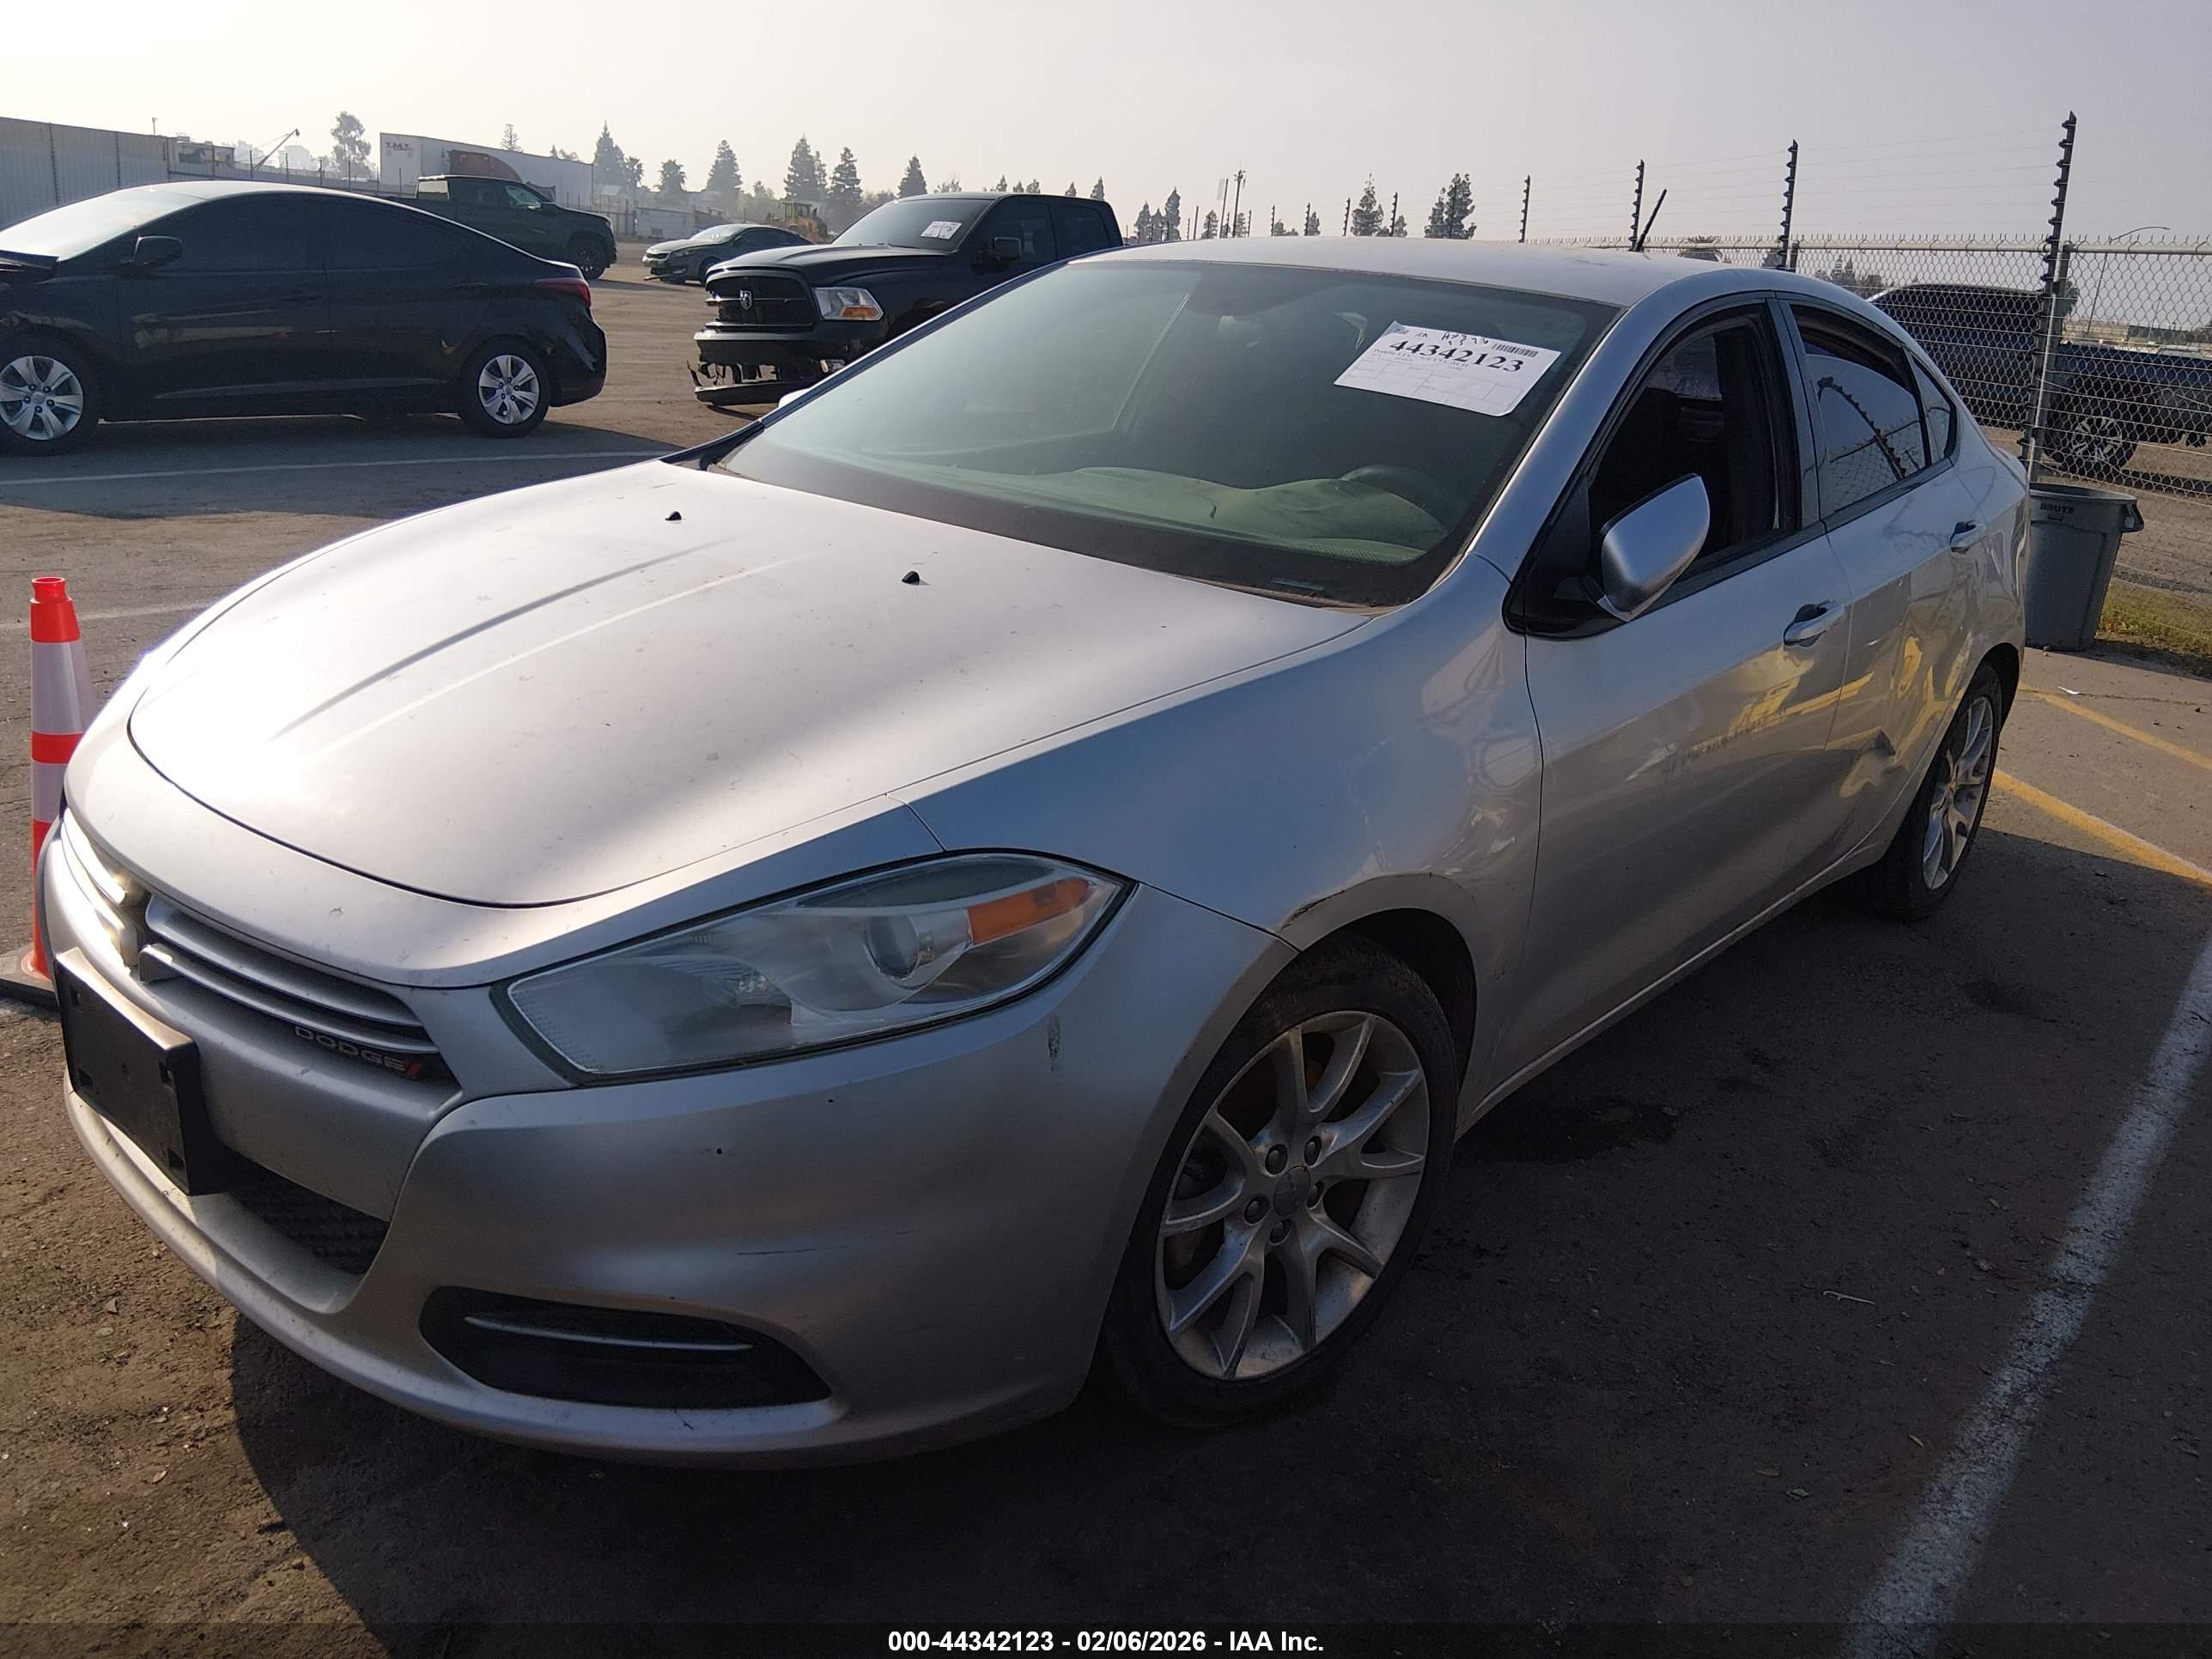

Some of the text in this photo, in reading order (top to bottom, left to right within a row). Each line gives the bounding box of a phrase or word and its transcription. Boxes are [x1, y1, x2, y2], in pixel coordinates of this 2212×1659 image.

[1389, 341, 1524, 372] 44342123
[2039, 503, 2075, 514] BRUTE
[295, 1026, 407, 1072] DODGE
